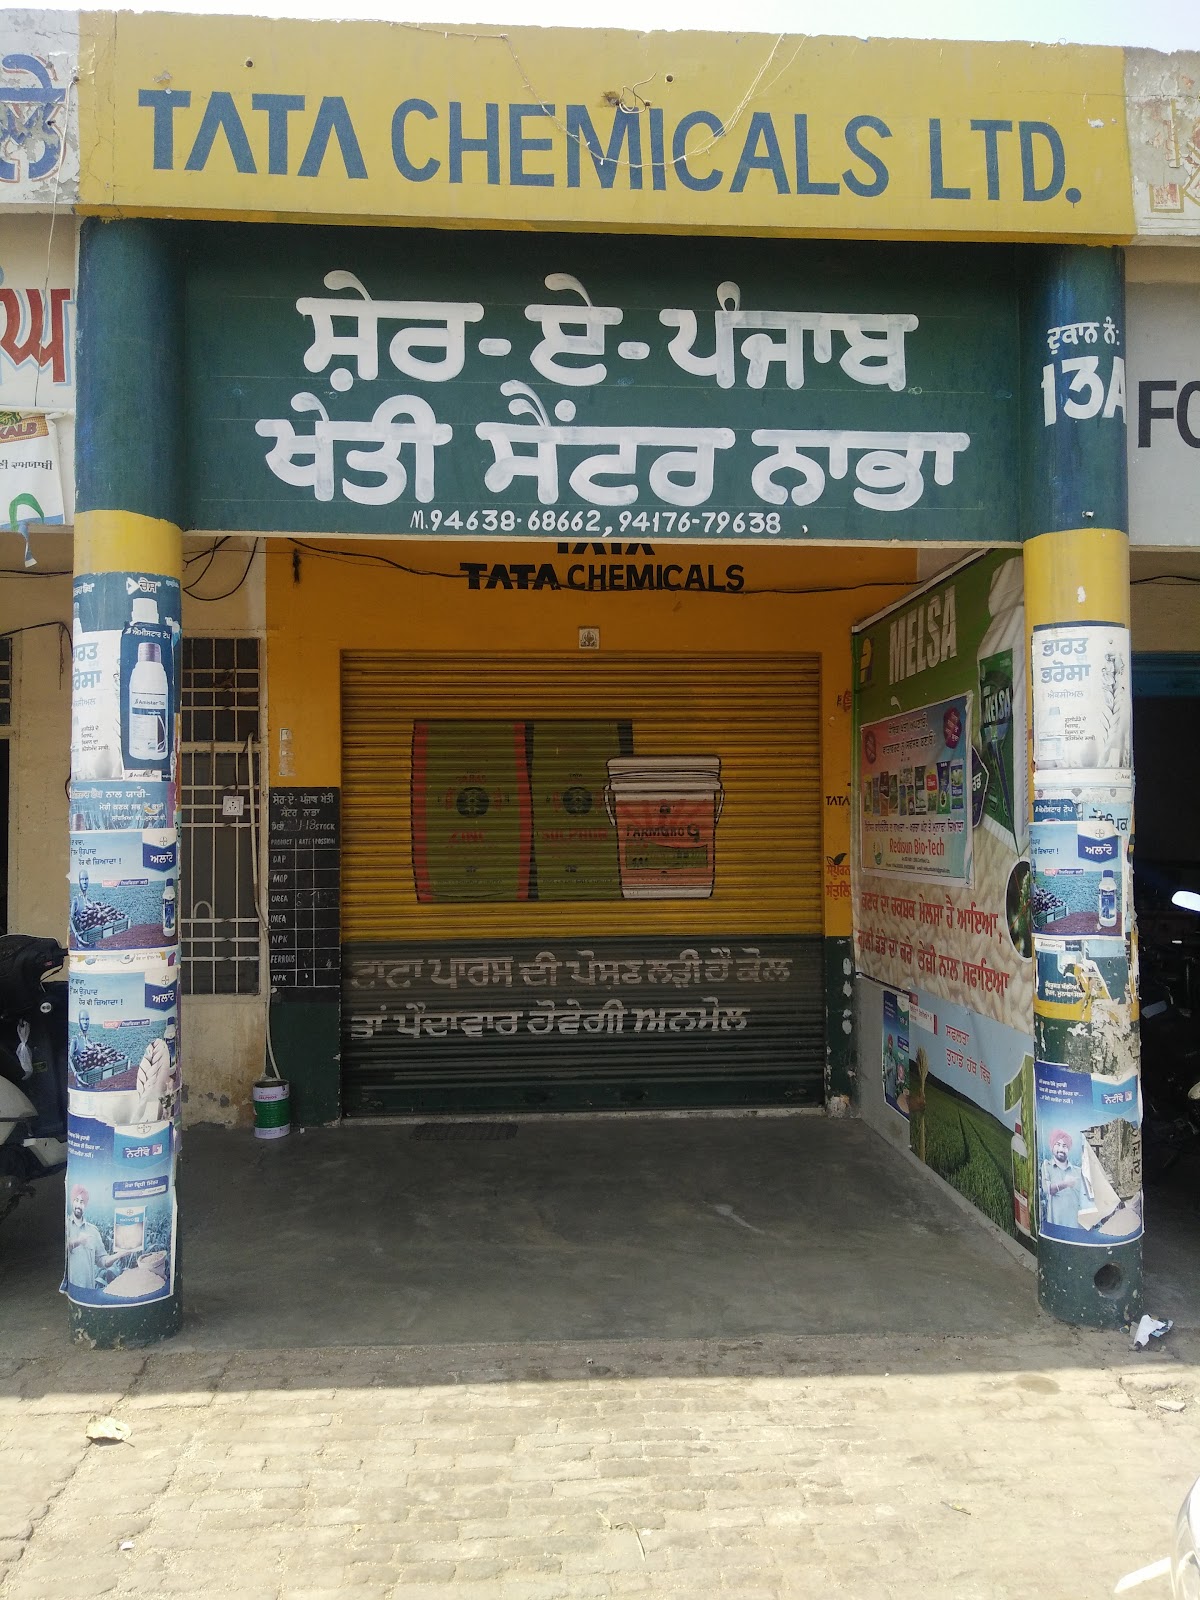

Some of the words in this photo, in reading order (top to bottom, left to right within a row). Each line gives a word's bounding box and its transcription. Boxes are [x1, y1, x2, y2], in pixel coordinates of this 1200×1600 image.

[138, 89, 368, 179] TATA
[391, 98, 892, 197] CHEMICALS
[930, 118, 1082, 204] LTD.
[1041, 356, 1127, 427] 13A
[255, 394, 453, 505] ਖੇਤੀ
[476, 380, 737, 506] ਸੈਂਟਰ
[751, 429, 970, 512] ਨਾਭਾ
[460, 562, 561, 590] TATA
[567, 564, 745, 591] CHEMICALS
[889, 585, 957, 685] MELSA
[1042, 638, 1089, 657] ਭਾਰਤ
[1040, 660, 1091, 683] ਭਰੋਸਾ
[826, 796, 850, 806] TATA
[273, 855, 286, 863] DAP
[273, 874, 288, 883] MOP
[271, 895, 288, 903] UREA
[270, 914, 286, 923] UREA
[271, 935, 288, 943] NPK
[270, 954, 295, 964] FERROUS
[939, 954, 960, 981] ਨਾਲ
[272, 974, 287, 982] NPK
[351, 959, 424, 988] ਟਾਟਾ
[519, 951, 562, 986] ਦੀ
